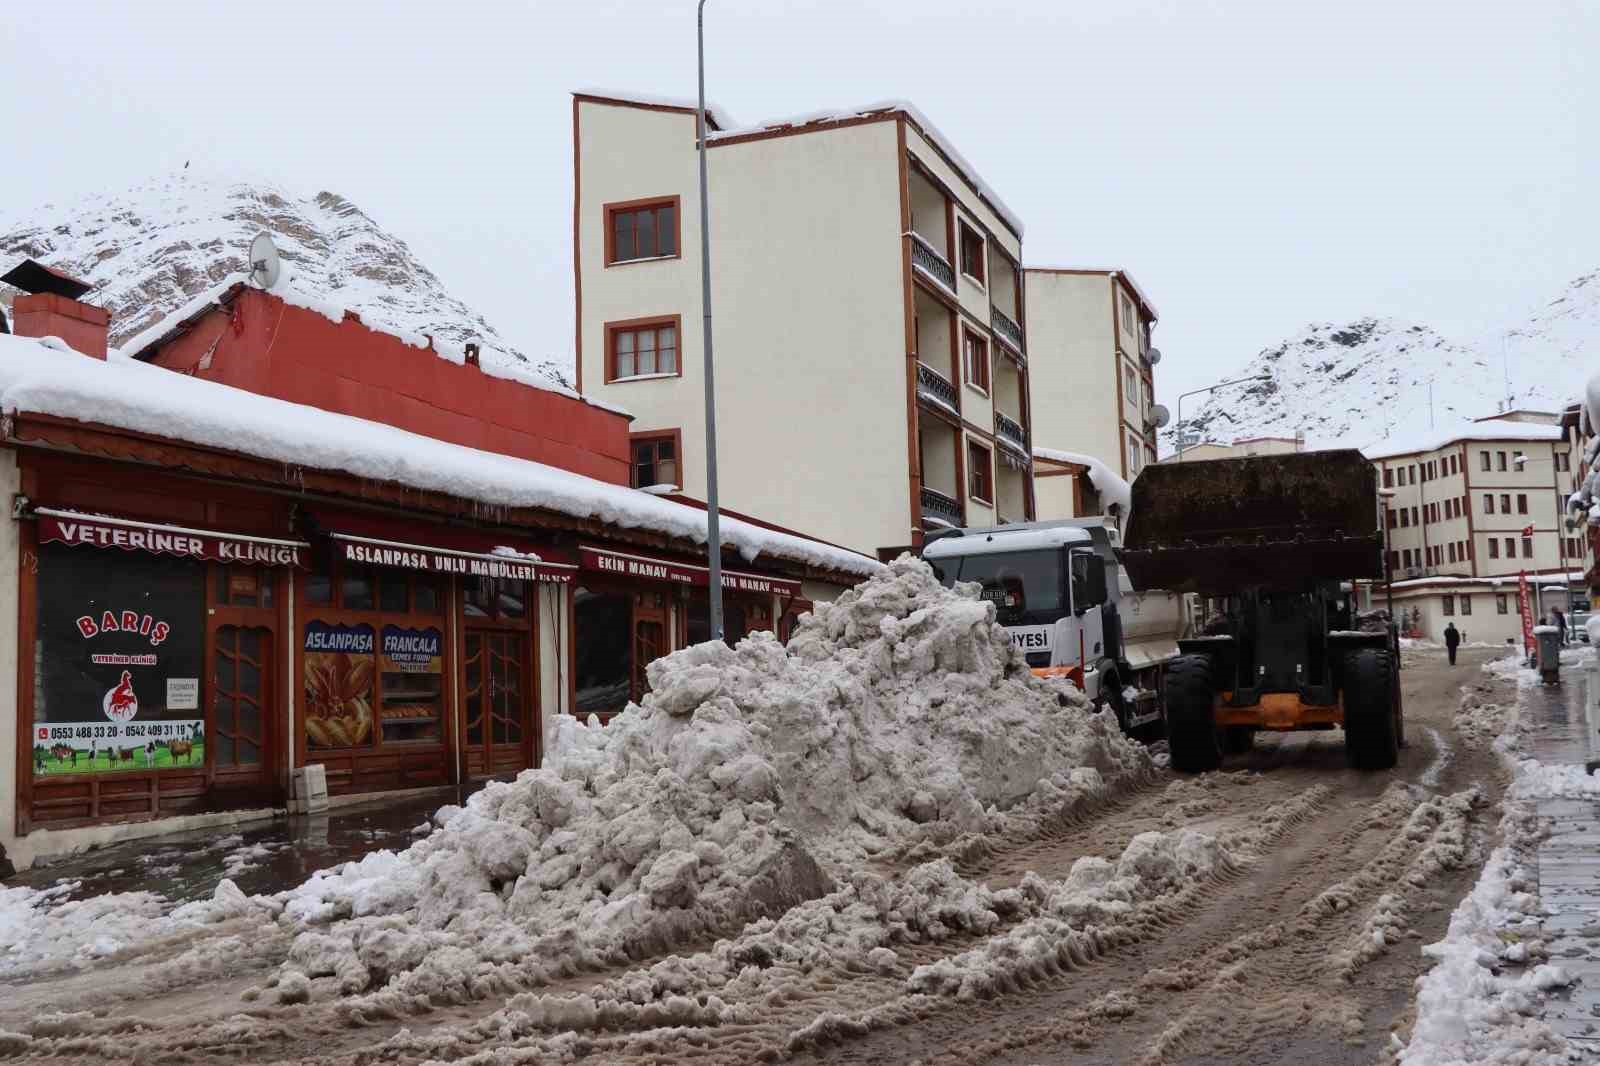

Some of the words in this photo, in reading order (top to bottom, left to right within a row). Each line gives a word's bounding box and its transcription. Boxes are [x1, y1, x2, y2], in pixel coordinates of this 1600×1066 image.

[57, 521, 204, 556] VETERİNER
[597, 555, 625, 572] EKİN
[629, 561, 667, 578] MANAV
[720, 574, 736, 588] KİN
[739, 577, 770, 592] MANAV
[76, 611, 170, 646] BARIŞ
[1008, 629, 1048, 647] İYESİ
[304, 631, 373, 653] ASLANPAŞA
[384, 635, 437, 654] FRANCALA
